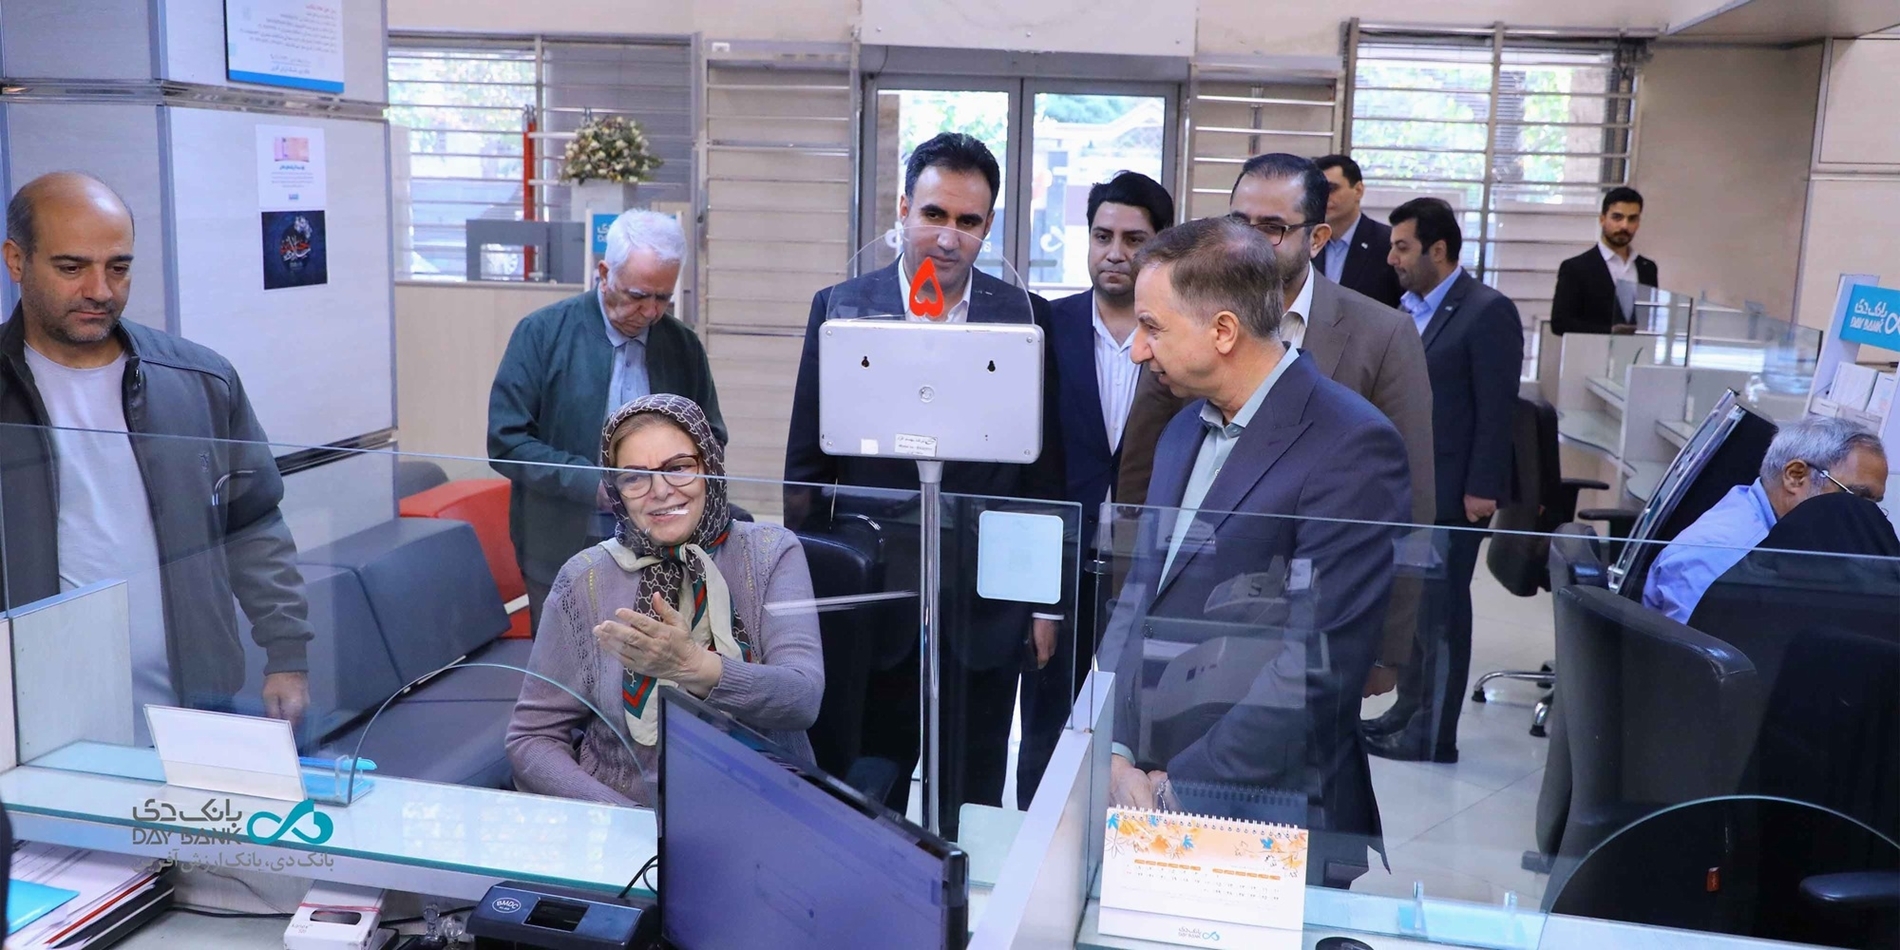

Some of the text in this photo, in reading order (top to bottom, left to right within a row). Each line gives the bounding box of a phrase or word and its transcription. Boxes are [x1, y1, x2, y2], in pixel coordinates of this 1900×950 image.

[1854, 298, 1869, 314] دی
[1850, 316, 1884, 333] DAY BANK
